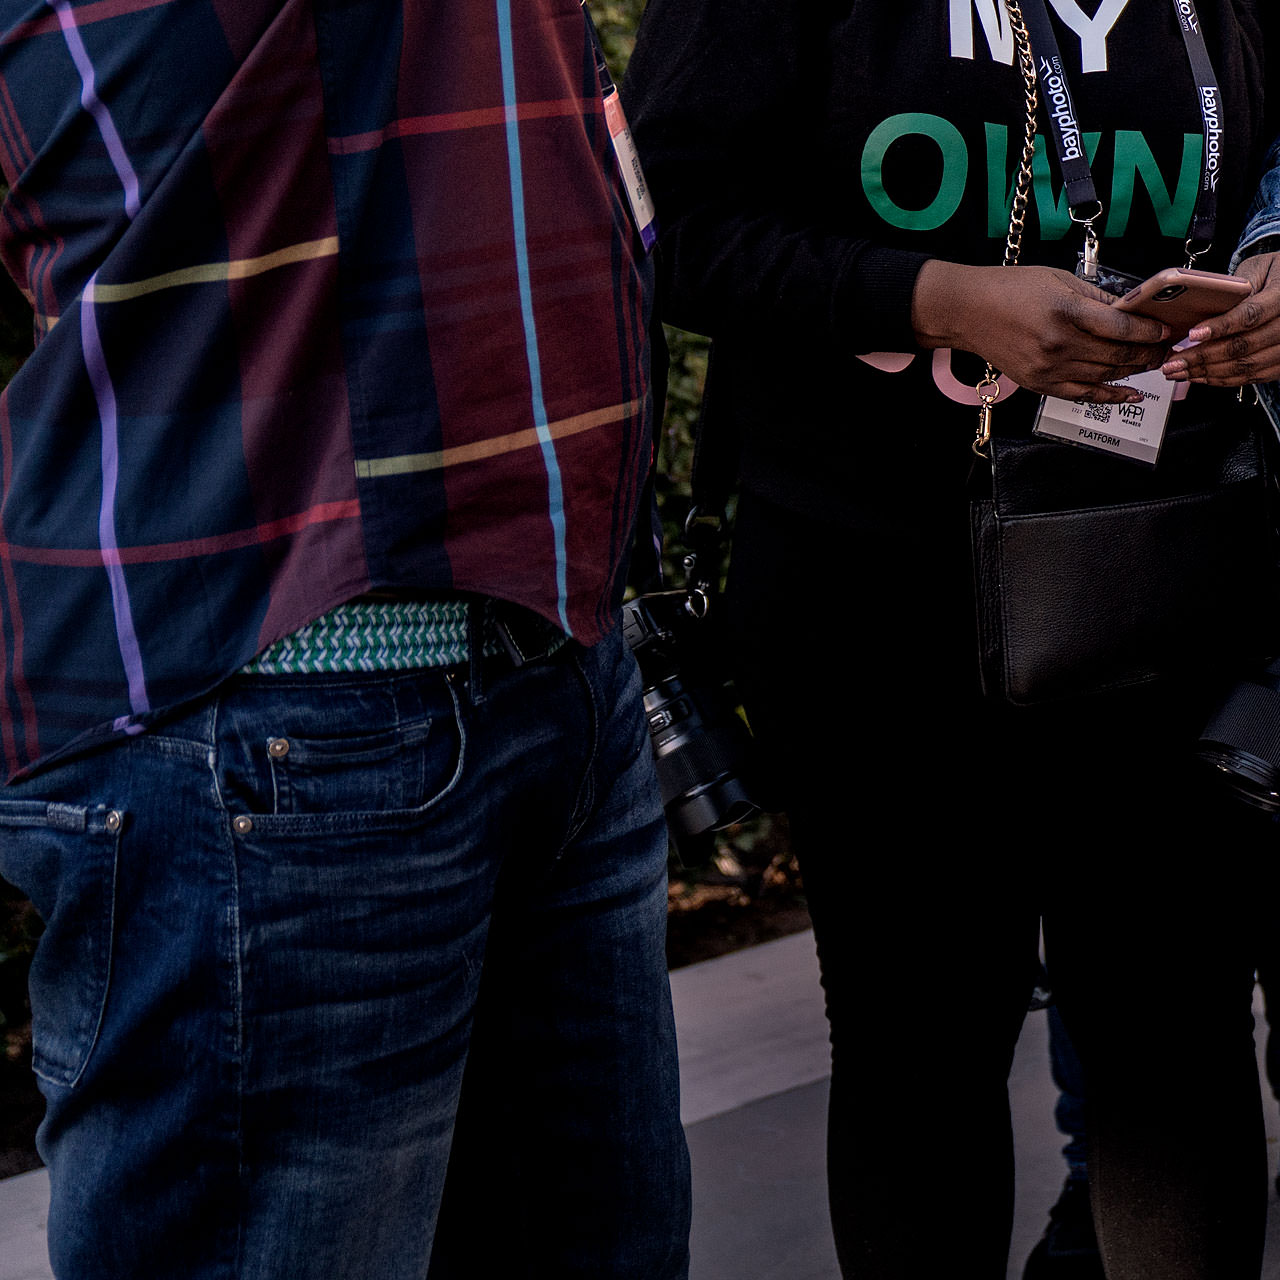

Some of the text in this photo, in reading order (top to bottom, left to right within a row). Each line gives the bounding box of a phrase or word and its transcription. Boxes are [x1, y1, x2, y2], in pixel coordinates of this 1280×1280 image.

[861, 113, 1203, 241] OWN
[1118, 403, 1145, 422] WPPI
[1078, 428, 1121, 448] PLATFORM
